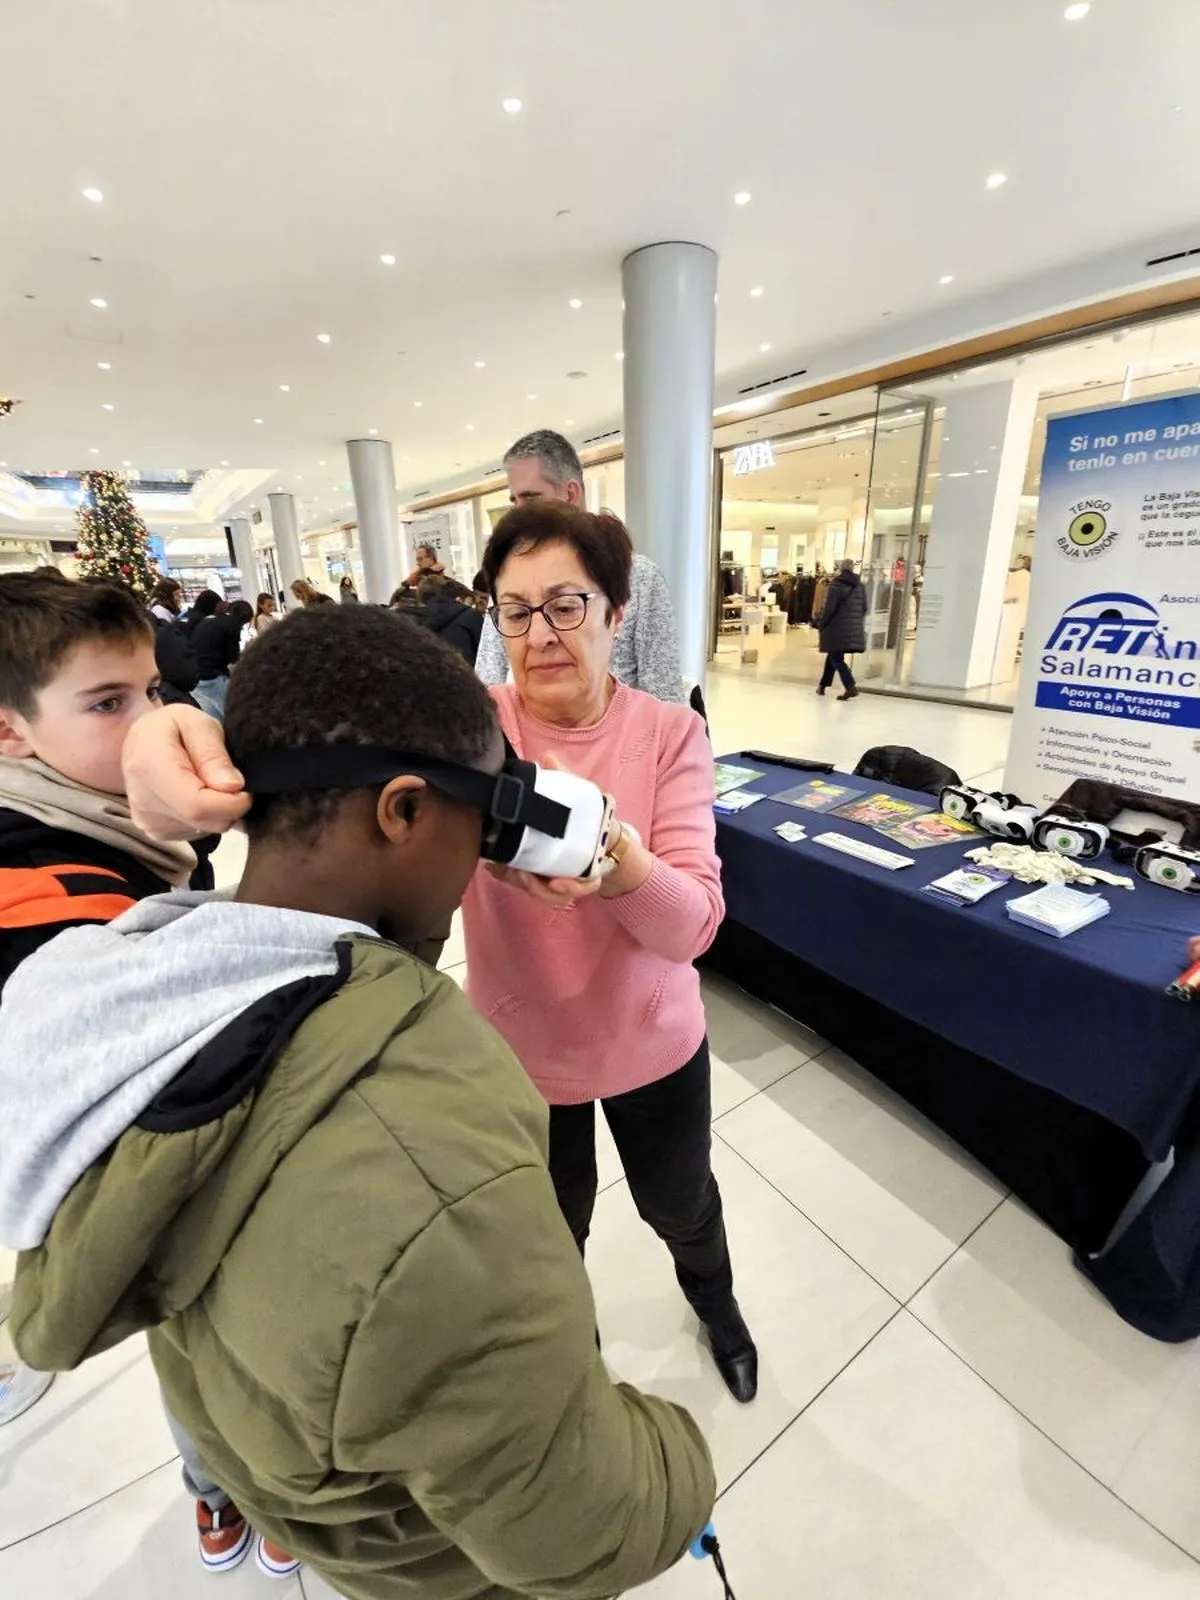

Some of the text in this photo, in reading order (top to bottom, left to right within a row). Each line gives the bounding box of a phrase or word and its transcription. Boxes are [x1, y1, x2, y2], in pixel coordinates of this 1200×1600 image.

[1069, 436, 1088, 452] Si
[1093, 434, 1118, 449] no
[1124, 429, 1157, 445] me
[1068, 454, 1116, 472] tenlo
[1122, 452, 1147, 465] en
[1068, 499, 1112, 514] TENGO
[1056, 537, 1080, 558] BAJA
[1040, 655, 1200, 688] Salamanc
[1060, 686, 1181, 709] Apoyo a Personas
[1068, 699, 1171, 720] con Baja Visión
